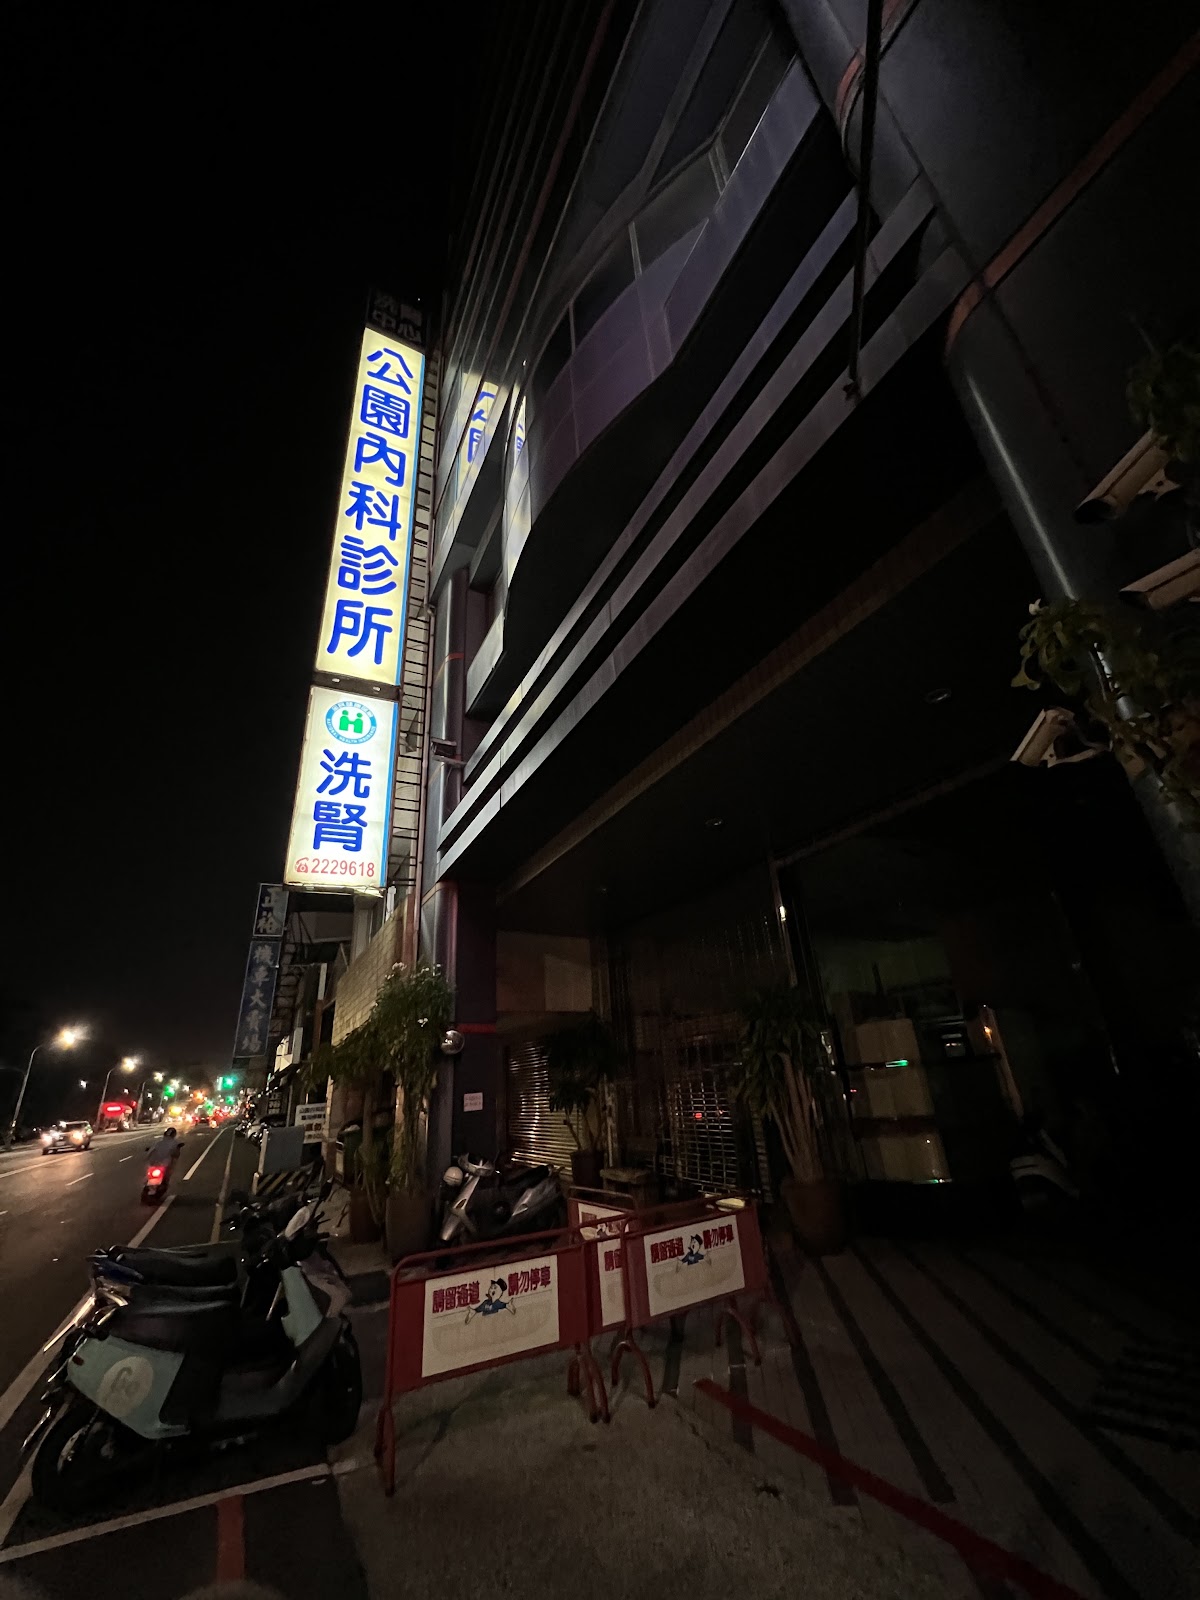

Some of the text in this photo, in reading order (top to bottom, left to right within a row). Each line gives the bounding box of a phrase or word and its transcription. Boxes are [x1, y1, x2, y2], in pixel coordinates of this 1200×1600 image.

[326, 347, 414, 665] 公園內科診所
[312, 748, 372, 852] 洗腎
[310, 857, 375, 878] 2229618
